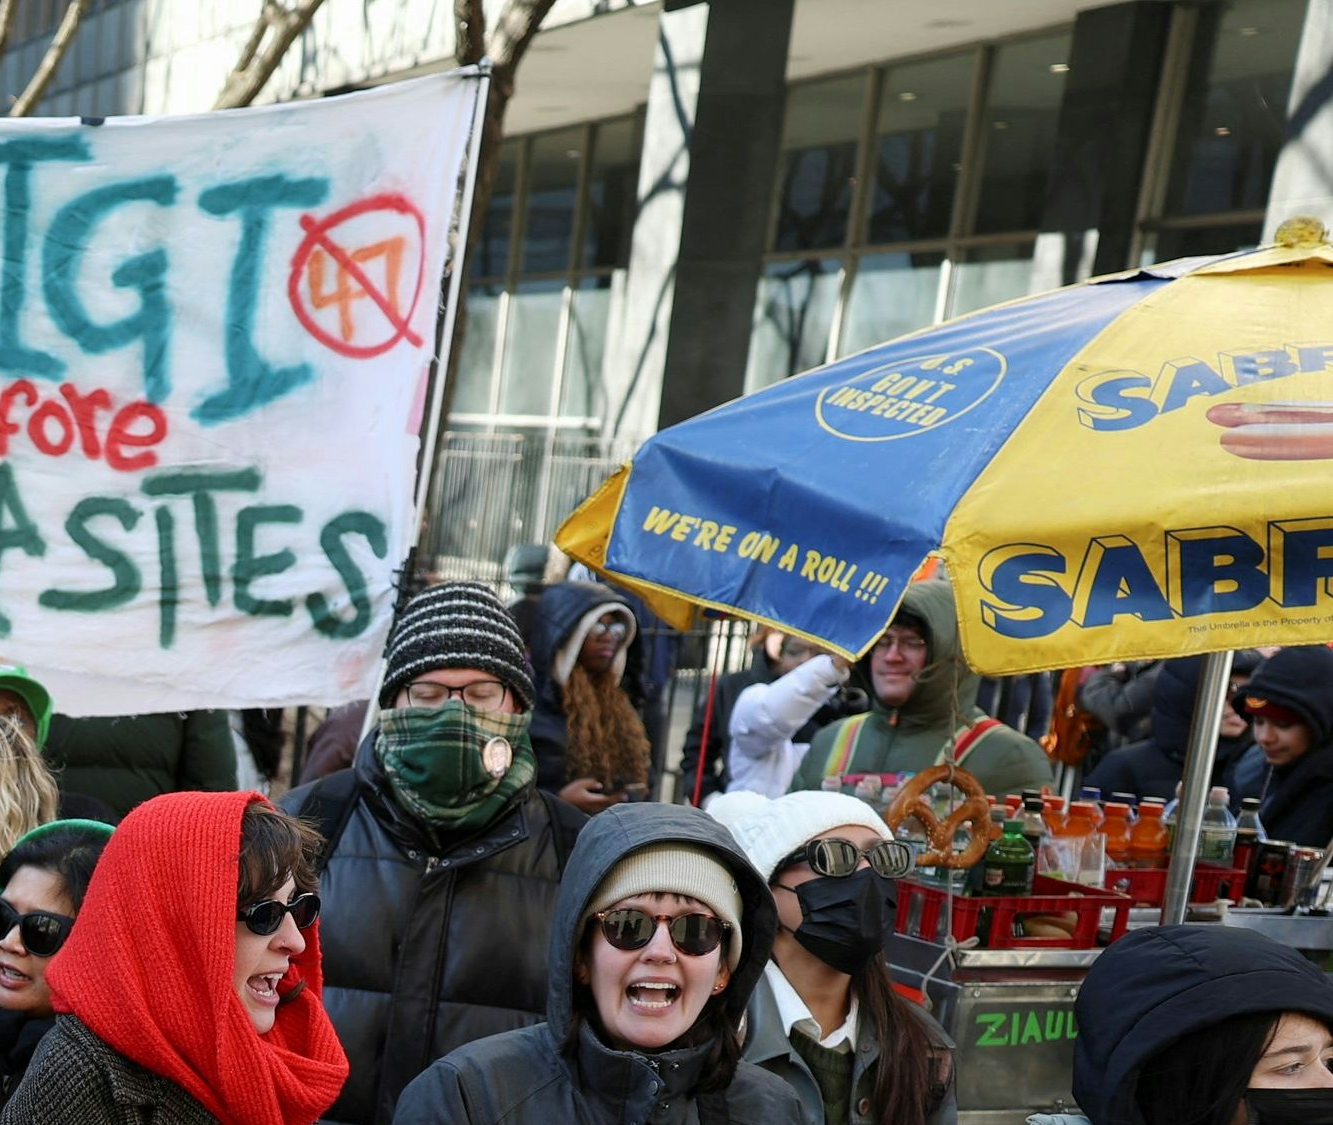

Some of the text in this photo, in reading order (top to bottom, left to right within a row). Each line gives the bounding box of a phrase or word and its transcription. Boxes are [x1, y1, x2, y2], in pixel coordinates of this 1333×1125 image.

[825, 386, 948, 427] INSPECTED
[642, 506, 737, 553] WE'RE
[737, 530, 780, 564] ON
[778, 543, 800, 572] A
[800, 549, 858, 593] ROLL
[1209, 620, 1250, 631] Umbrella
[1252, 620, 1261, 628] is
[1263, 619, 1278, 627] the
[1280, 615, 1322, 627] Property
